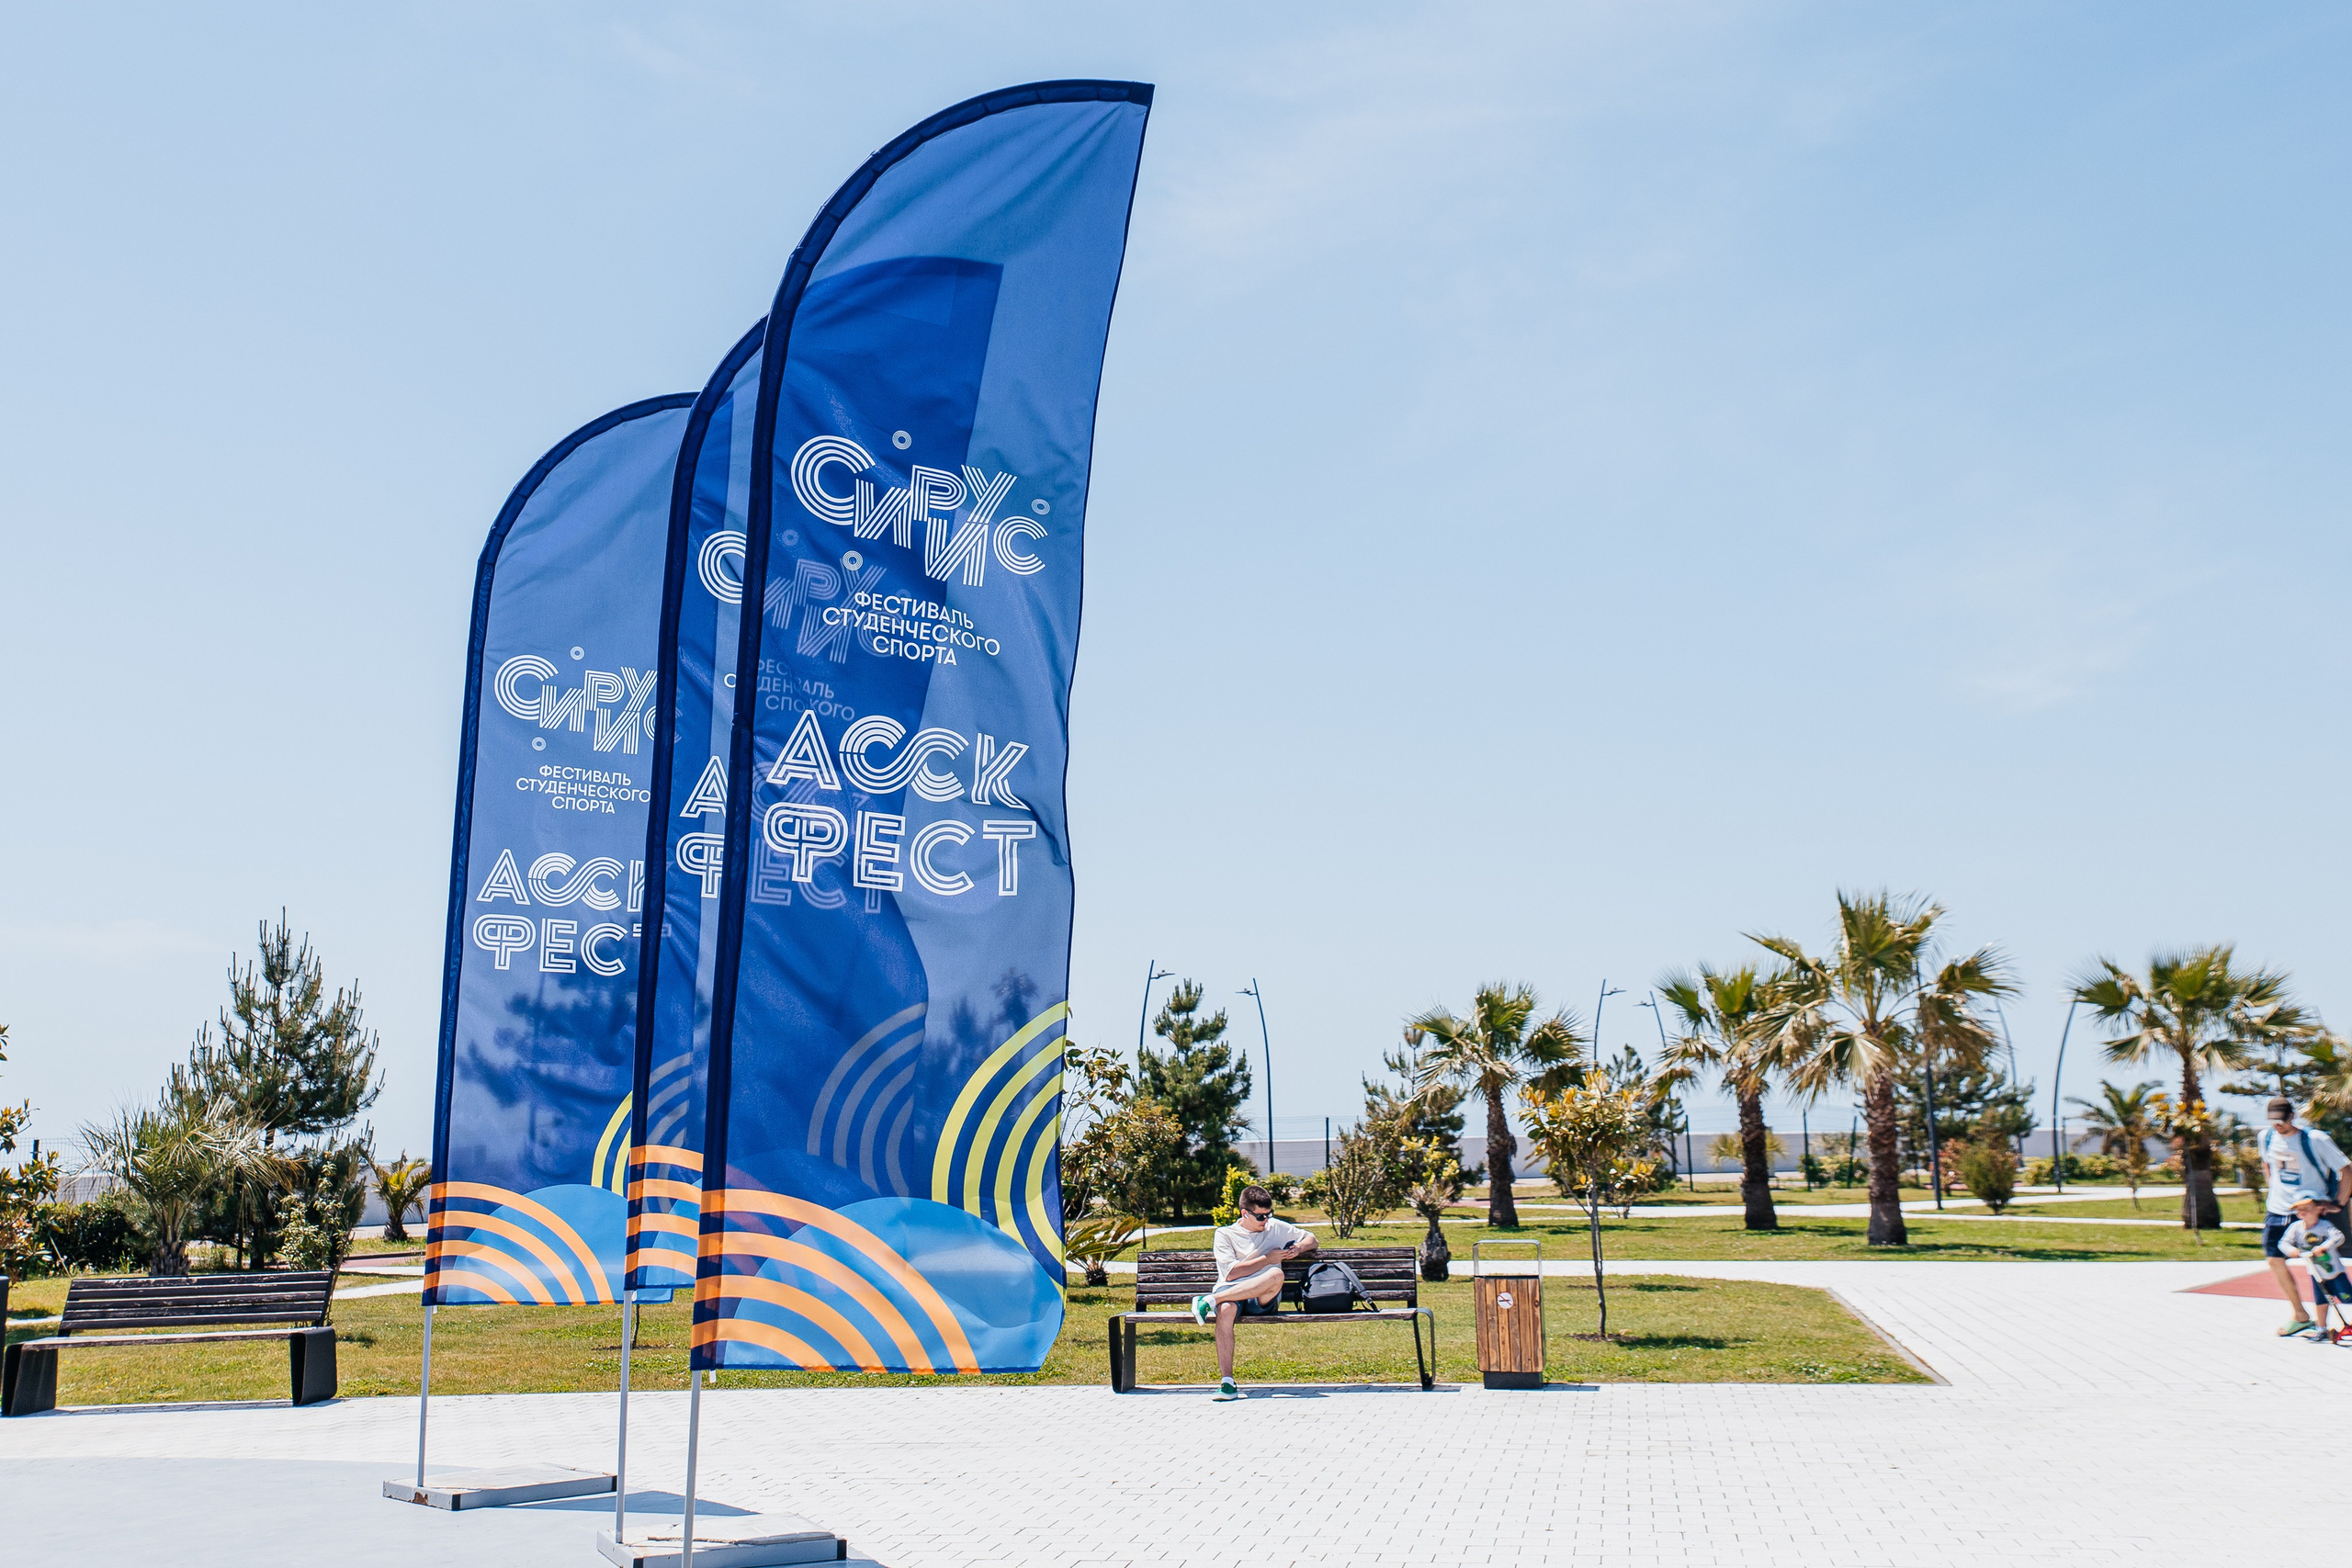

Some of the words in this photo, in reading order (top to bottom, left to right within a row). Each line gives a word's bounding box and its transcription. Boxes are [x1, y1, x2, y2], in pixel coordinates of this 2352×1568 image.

[853, 591, 974, 628] ФЕСТИВАЛЬ
[821, 606, 1001, 657] СТУДЕНЧЕСКОГО
[872, 635, 957, 666] СПОРТА
[539, 764, 632, 786] ФЕСТИВАЛЬ
[765, 709, 1031, 811] АССК
[515, 777, 651, 803] СТУДЕНЧЕСКОГО
[551, 795, 616, 815] СПОРТА
[763, 802, 1037, 897] ФЕСТ
[472, 913, 642, 977] ФЕС
